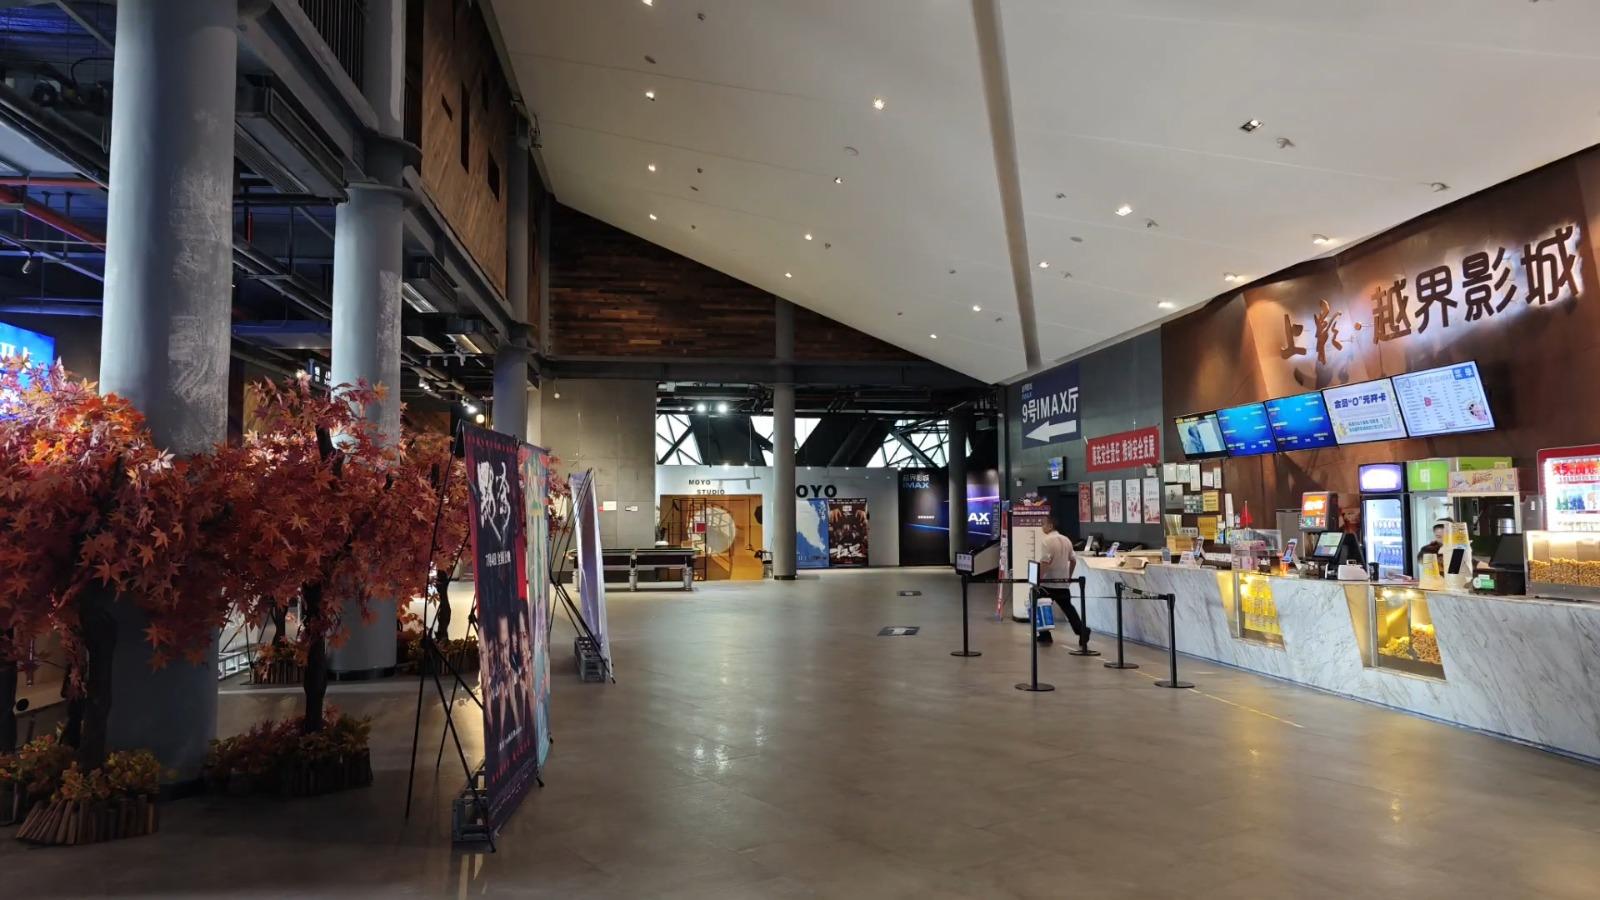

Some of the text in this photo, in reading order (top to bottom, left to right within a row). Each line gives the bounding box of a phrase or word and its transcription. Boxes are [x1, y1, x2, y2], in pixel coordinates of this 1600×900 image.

[1022, 386, 1079, 424] 9号IMAX厅
[796, 484, 838, 498] OYO
[968, 512, 990, 522] AX
